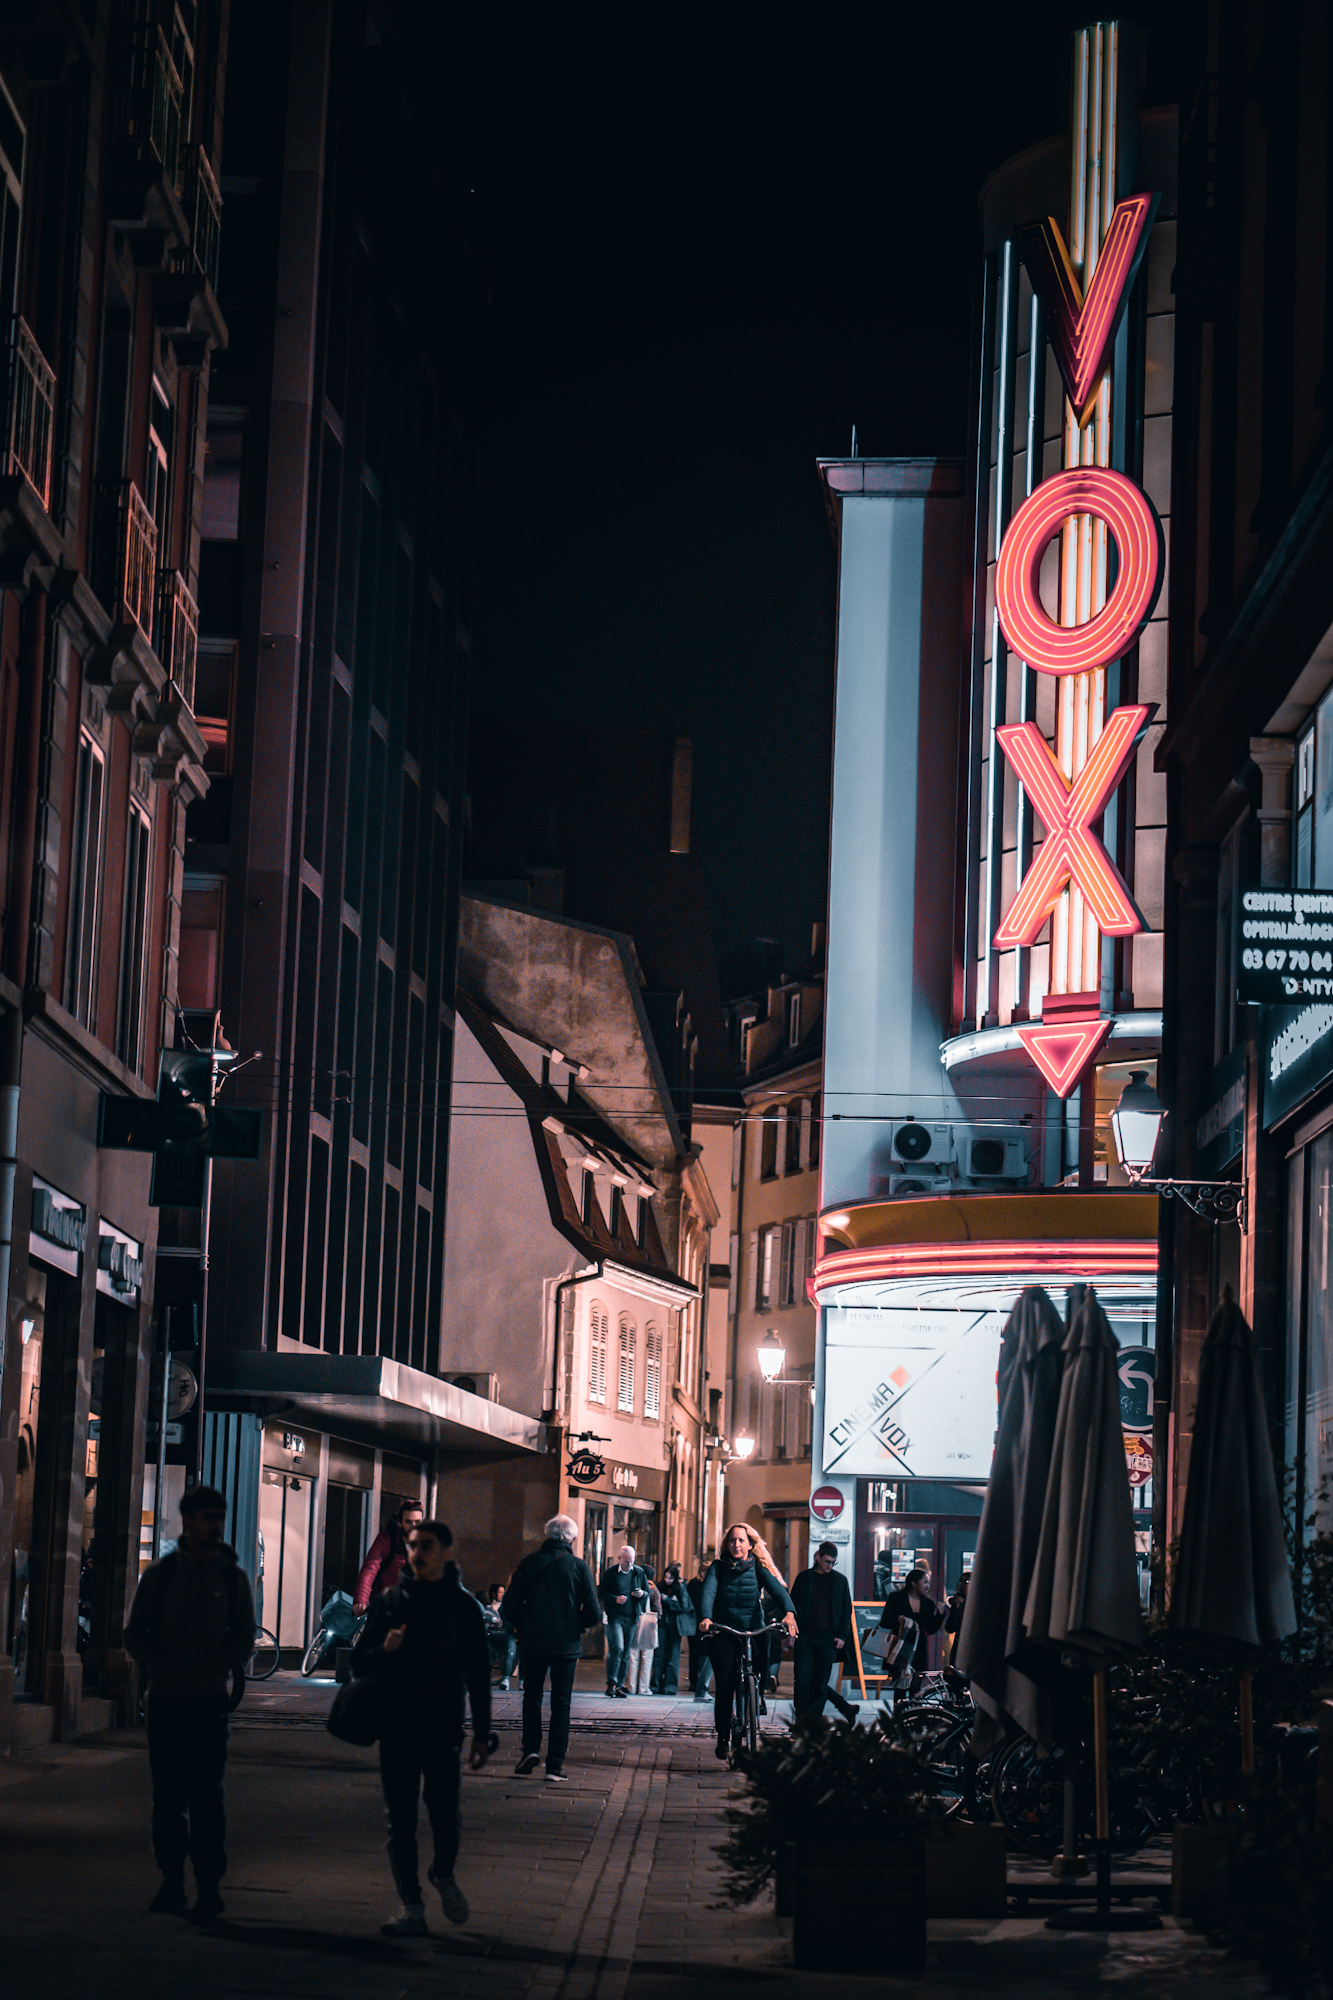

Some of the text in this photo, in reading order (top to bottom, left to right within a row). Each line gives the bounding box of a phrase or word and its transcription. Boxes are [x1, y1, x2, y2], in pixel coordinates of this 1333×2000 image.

[991, 190, 1164, 950] VOX
[1243, 892, 1292, 912] CENTRE
[1243, 948, 1333, 972] 03 67 70 04
[829, 1382, 895, 1447] CINEMA
[879, 1416, 916, 1457] VOX
[571, 1461, 601, 1475] Au 5
